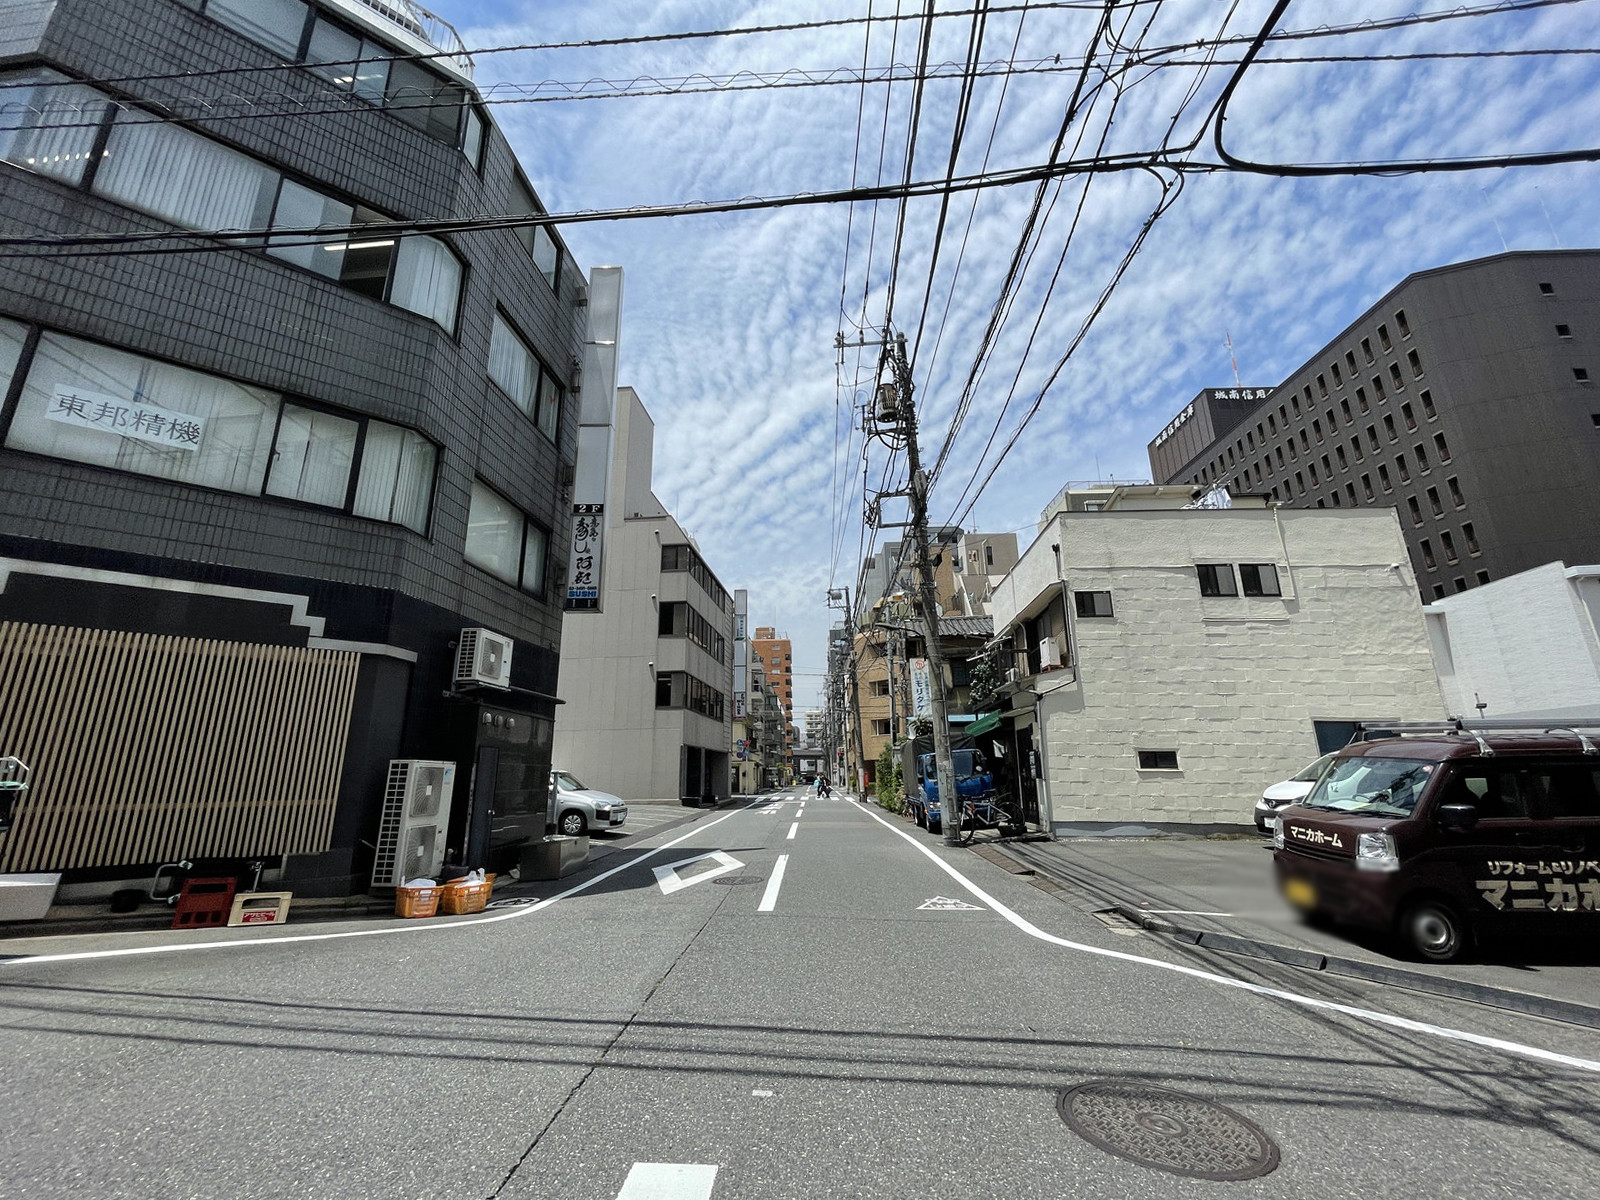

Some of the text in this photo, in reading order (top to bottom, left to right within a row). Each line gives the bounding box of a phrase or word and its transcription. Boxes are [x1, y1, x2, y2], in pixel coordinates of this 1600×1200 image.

[1214, 389, 1274, 401] 城南信用
[49, 392, 202, 446] 東邦精機
[1155, 403, 1194, 448] 城南信用金庫
[568, 590, 597, 598] SUSHI
[915, 680, 925, 712] モリタケ
[1290, 826, 1343, 848] マニカホーム
[1475, 877, 1600, 912] マニカホ
